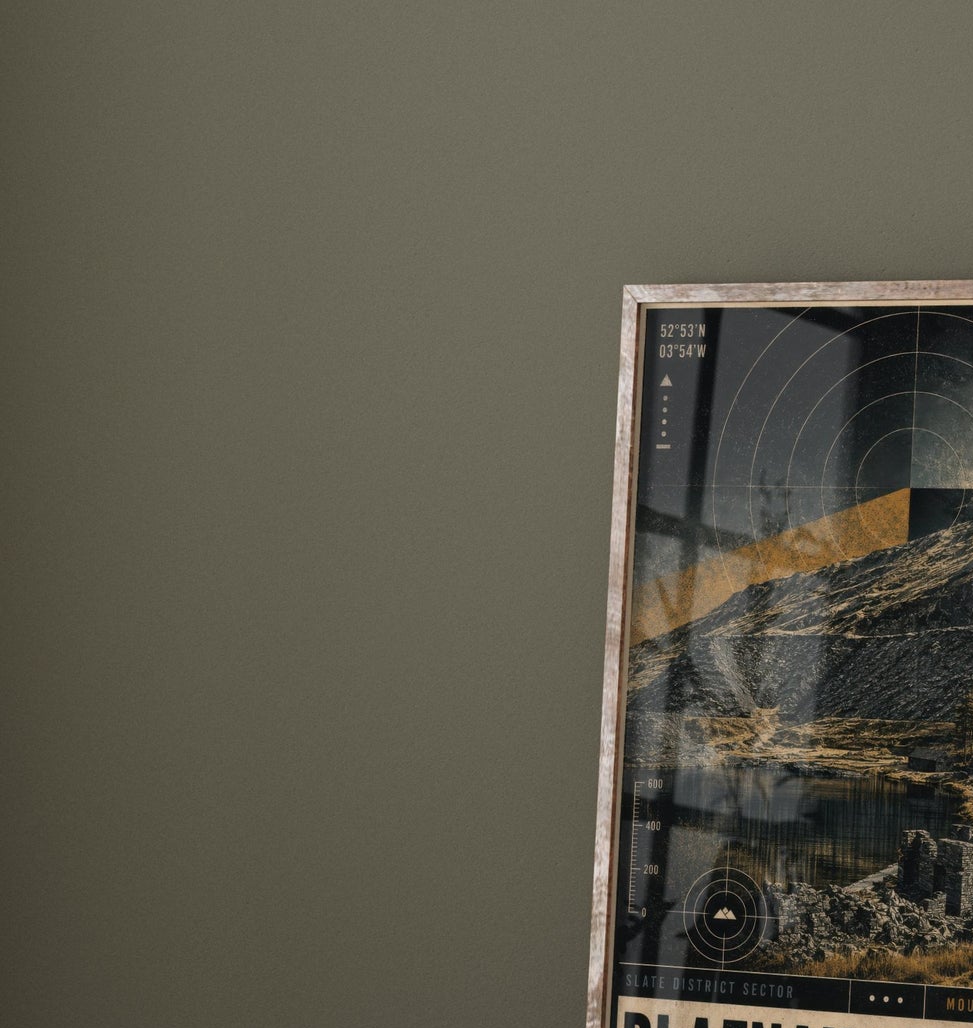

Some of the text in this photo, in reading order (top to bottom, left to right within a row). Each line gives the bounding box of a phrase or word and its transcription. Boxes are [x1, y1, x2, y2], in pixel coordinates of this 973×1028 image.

[647, 778, 663, 789] 600
[645, 820, 661, 831] 400
[643, 864, 659, 875] 200
[641, 907, 647, 917] 0
[625, 973, 793, 999] SLATE DISTRICT SECTOR
